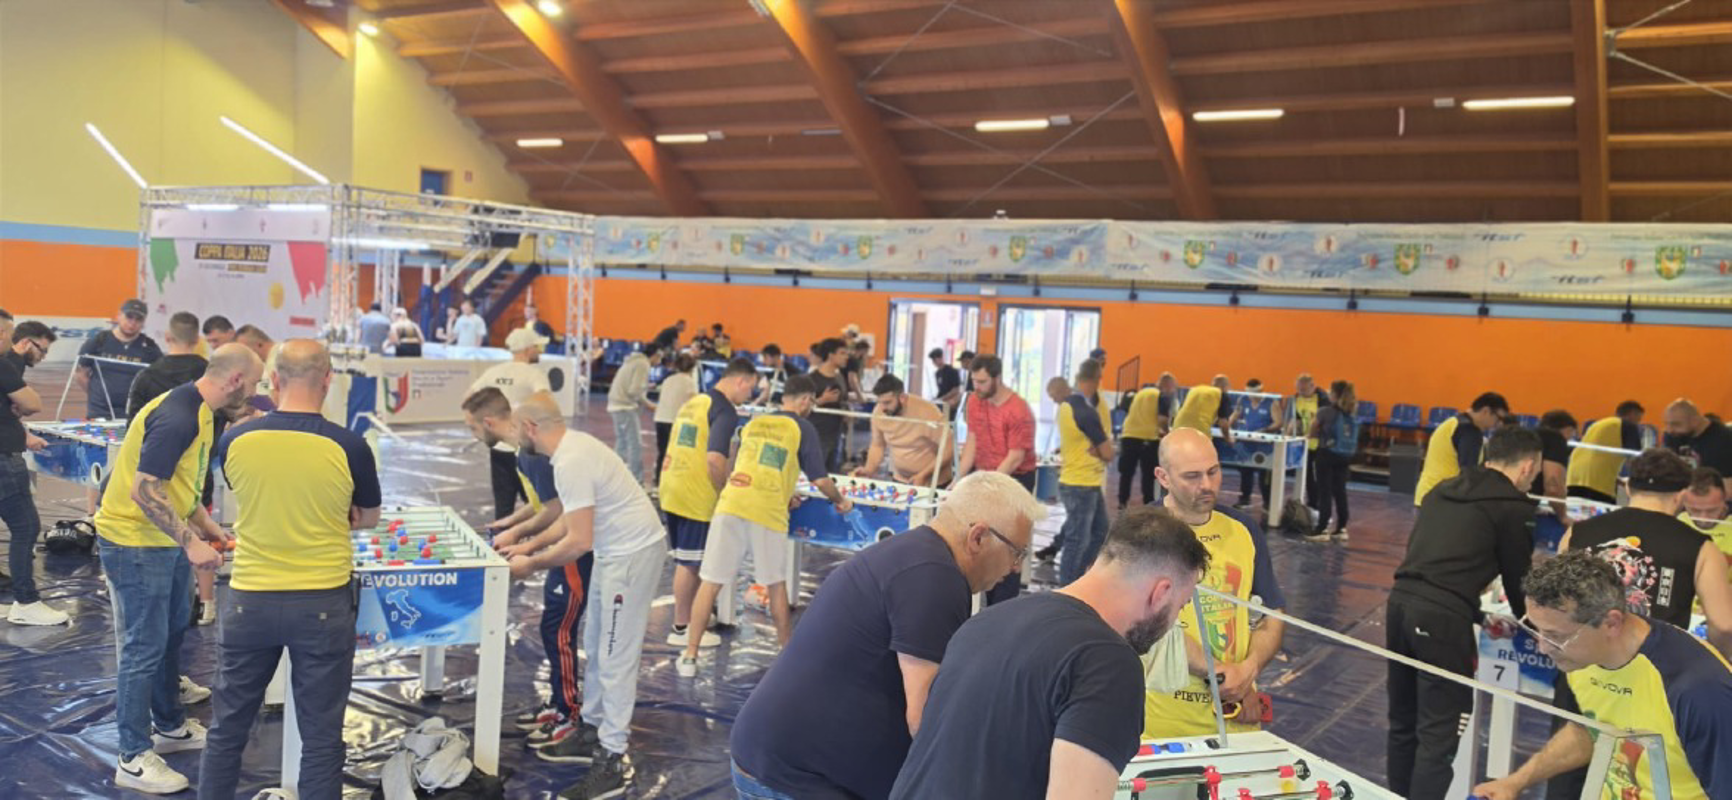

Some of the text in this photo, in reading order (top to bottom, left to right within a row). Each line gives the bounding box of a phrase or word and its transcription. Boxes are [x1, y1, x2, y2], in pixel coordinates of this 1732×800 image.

[360, 572, 458, 588] EVOLUTION
[1497, 649, 1556, 669] REVOLU
[1493, 664, 1505, 682] 7
[1174, 690, 1211, 703] PIEVE
